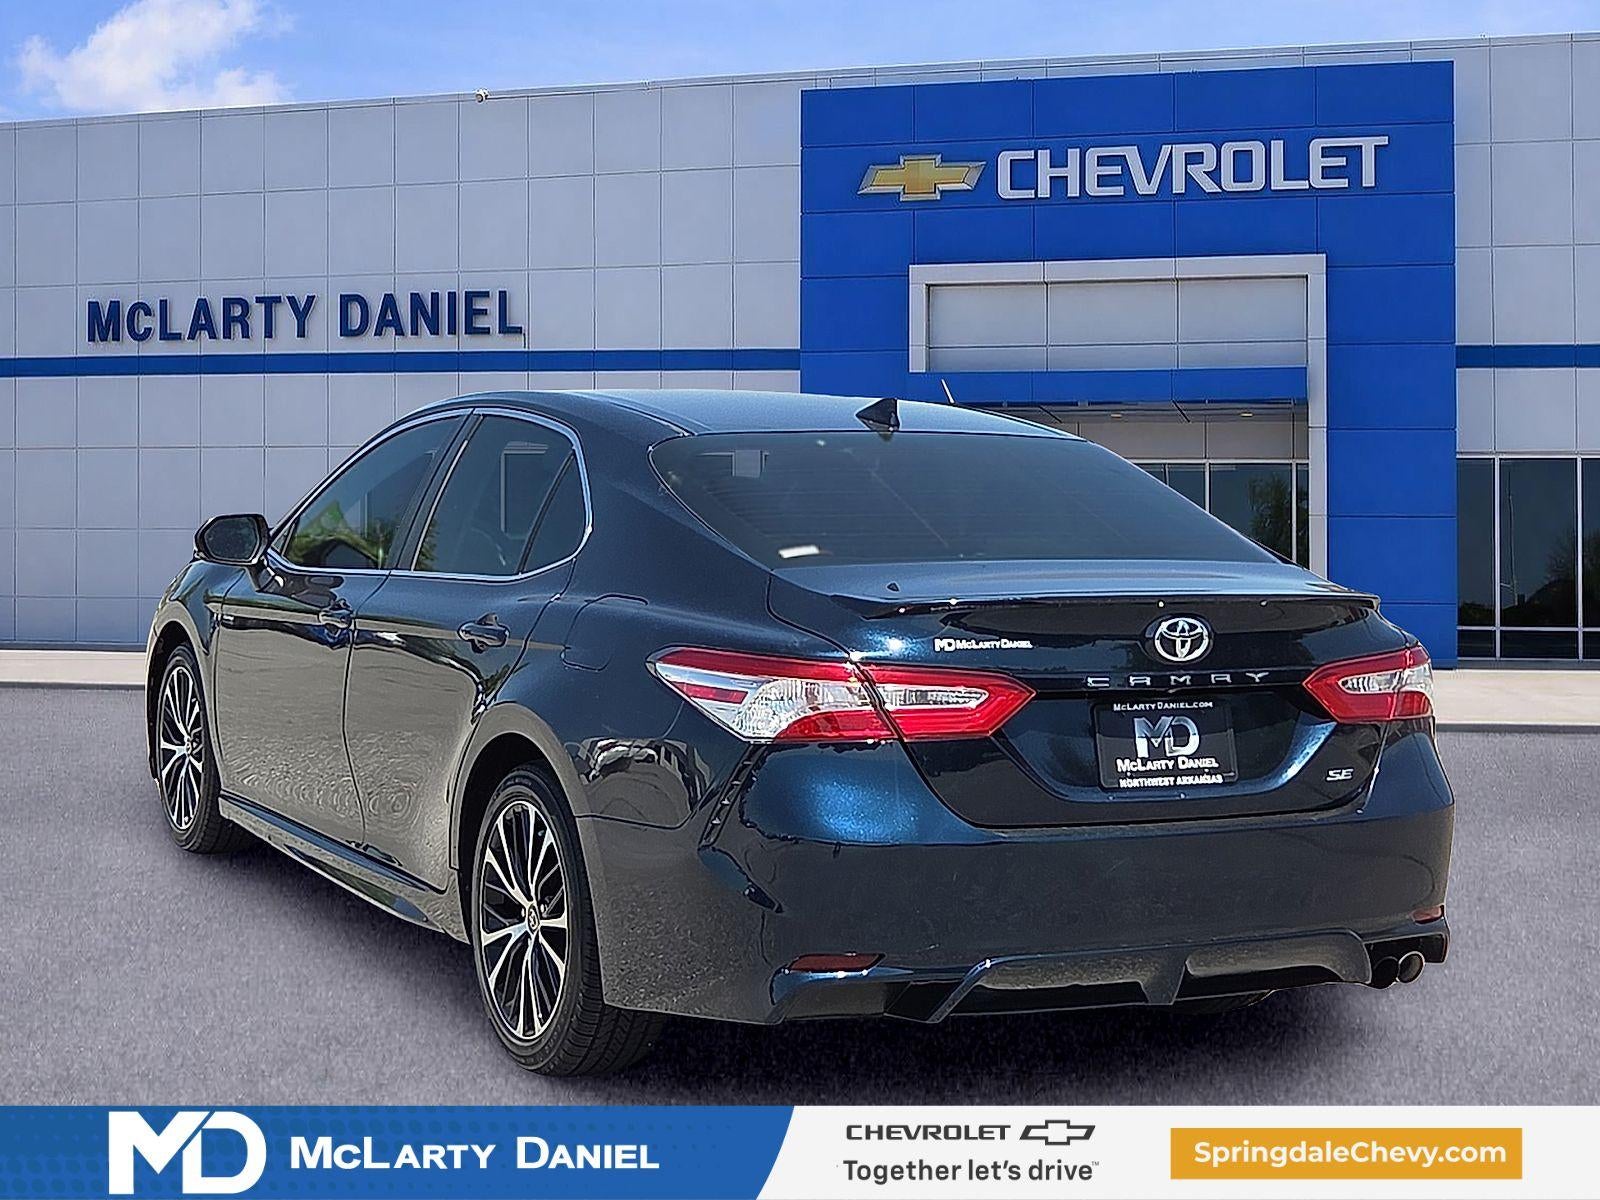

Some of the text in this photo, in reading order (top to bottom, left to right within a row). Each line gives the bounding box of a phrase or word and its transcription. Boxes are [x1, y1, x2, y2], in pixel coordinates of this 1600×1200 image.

[996, 135, 1389, 200] CHEVROLET
[338, 290, 524, 337] DANIEL
[934, 638, 955, 652] MD
[1087, 672, 1269, 687] CAMRY
[1134, 715, 1200, 758] MD
[1177, 756, 1219, 769] DANIEL
[1119, 774, 1223, 788] NORTHWEST ARKANSAS
[1326, 769, 1354, 781] SE
